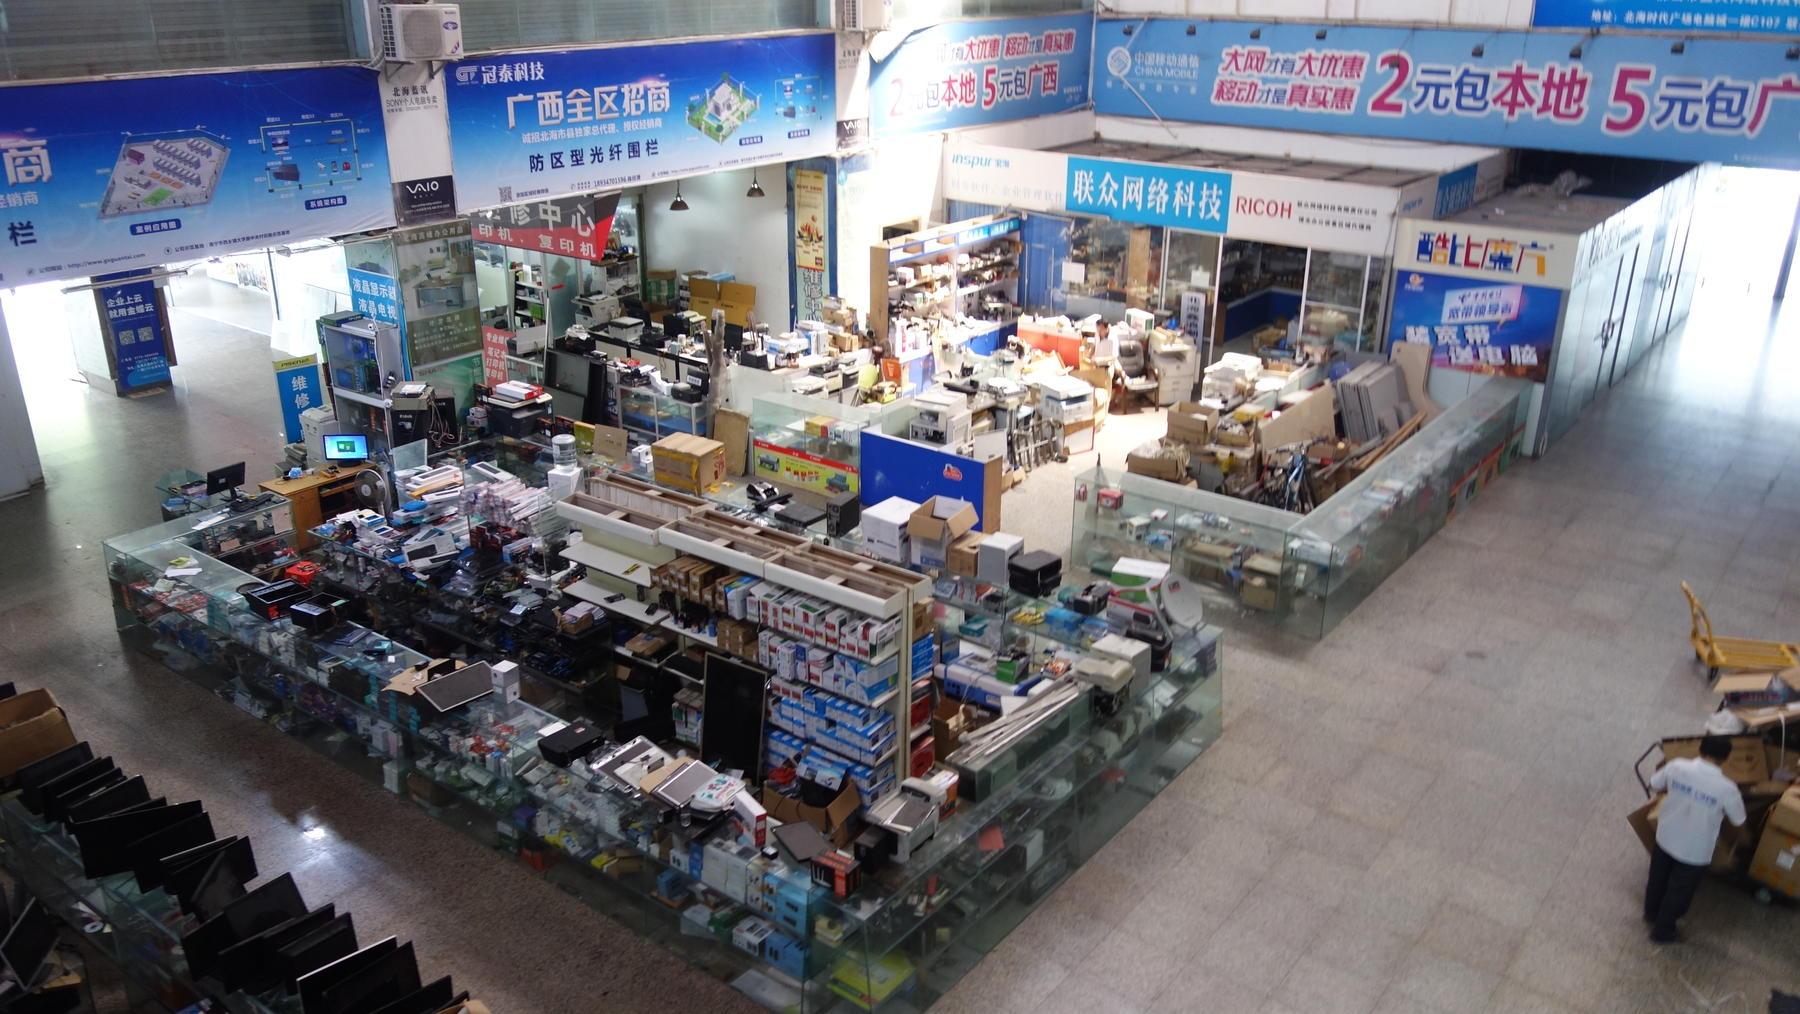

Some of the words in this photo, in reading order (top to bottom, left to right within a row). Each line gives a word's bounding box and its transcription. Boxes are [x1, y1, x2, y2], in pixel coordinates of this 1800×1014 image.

[1004, 32, 1075, 57] 移动才是真实惠
[1134, 52, 1200, 68] 中国移动通信
[1221, 49, 1365, 79] 大网才有大优惠
[482, 62, 545, 84] 冠泰科技
[1134, 65, 1163, 77] CHINA
[1165, 67, 1199, 80] MOBILE
[982, 62, 1058, 108] 5元包广西
[1214, 80, 1357, 111] 移动才是真实惠
[1370, 51, 1590, 121] 2元包本地
[507, 82, 670, 129] 广西全区招商
[843, 121, 861, 130] VAIO
[0, 139, 52, 187] 商
[529, 139, 659, 173] 防区型光纤围栏
[952, 154, 992, 168] inspur
[406, 181, 439, 194] VAIO
[1073, 169, 1223, 222] 联众网络科技
[1235, 196, 1292, 219] RICOH
[8, 220, 37, 247] 栏
[106, 294, 143, 308] 企业上云
[352, 278, 396, 300] 液晶显示器
[109, 303, 154, 318] 就用金蝶云
[358, 299, 397, 320] 液晶电视
[291, 375, 311, 408] 维修
